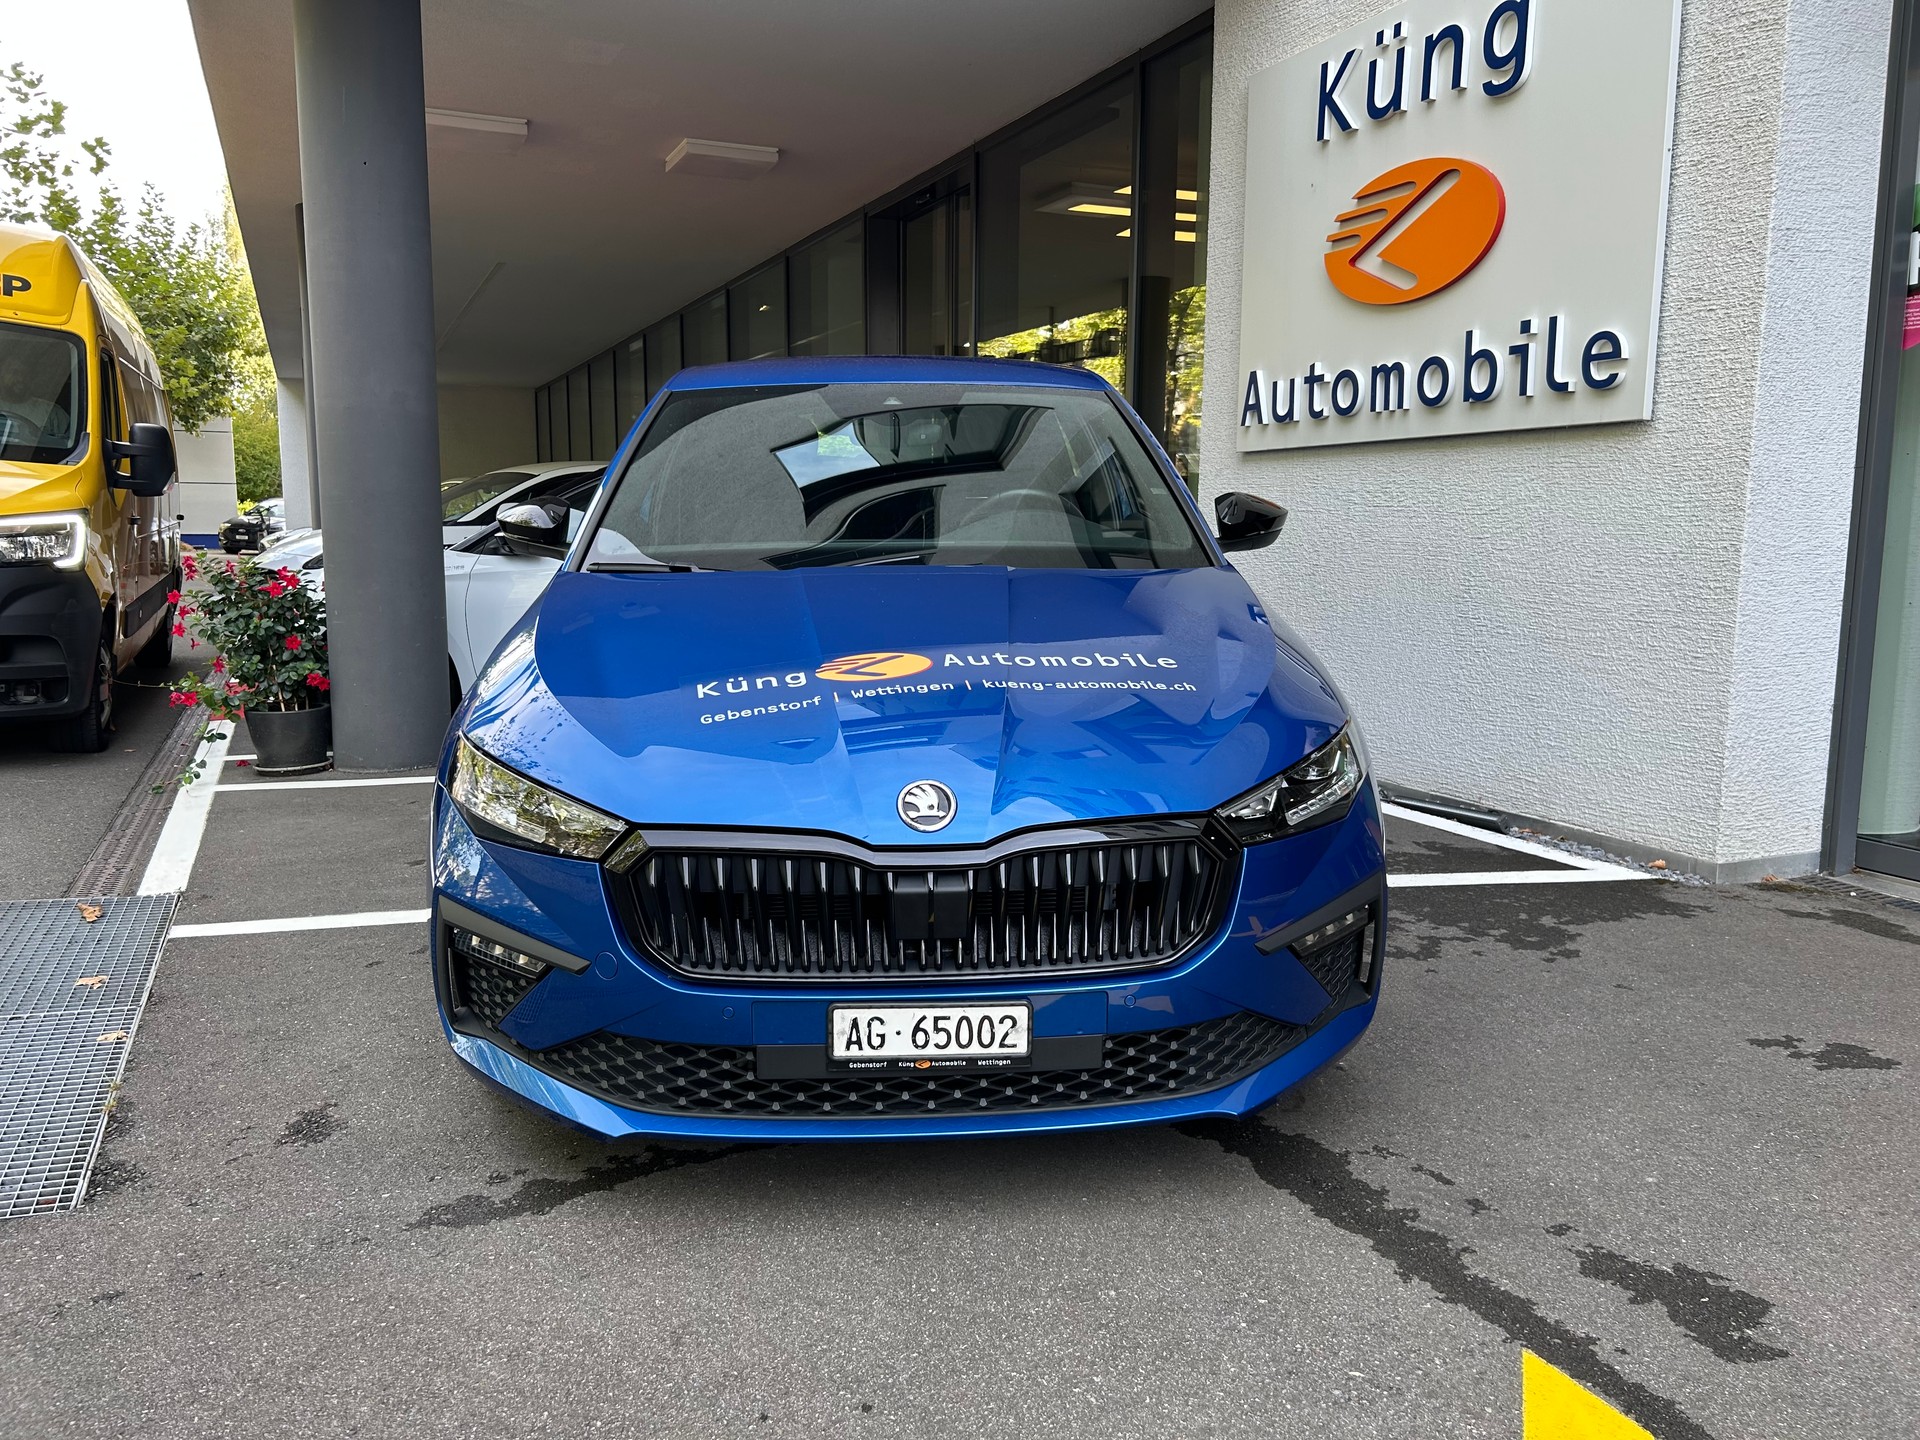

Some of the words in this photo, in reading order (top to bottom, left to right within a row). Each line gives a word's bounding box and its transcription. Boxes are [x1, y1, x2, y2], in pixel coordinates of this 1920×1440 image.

[1316, 0, 1533, 142] Küng
[1240, 315, 1629, 428] Automobile
[696, 671, 808, 699] Küng
[943, 652, 1178, 669] Automobile
[700, 695, 822, 725] Gebenstorf
[851, 682, 954, 700] Wettingen
[983, 679, 1197, 692] kueng-automobile.ch
